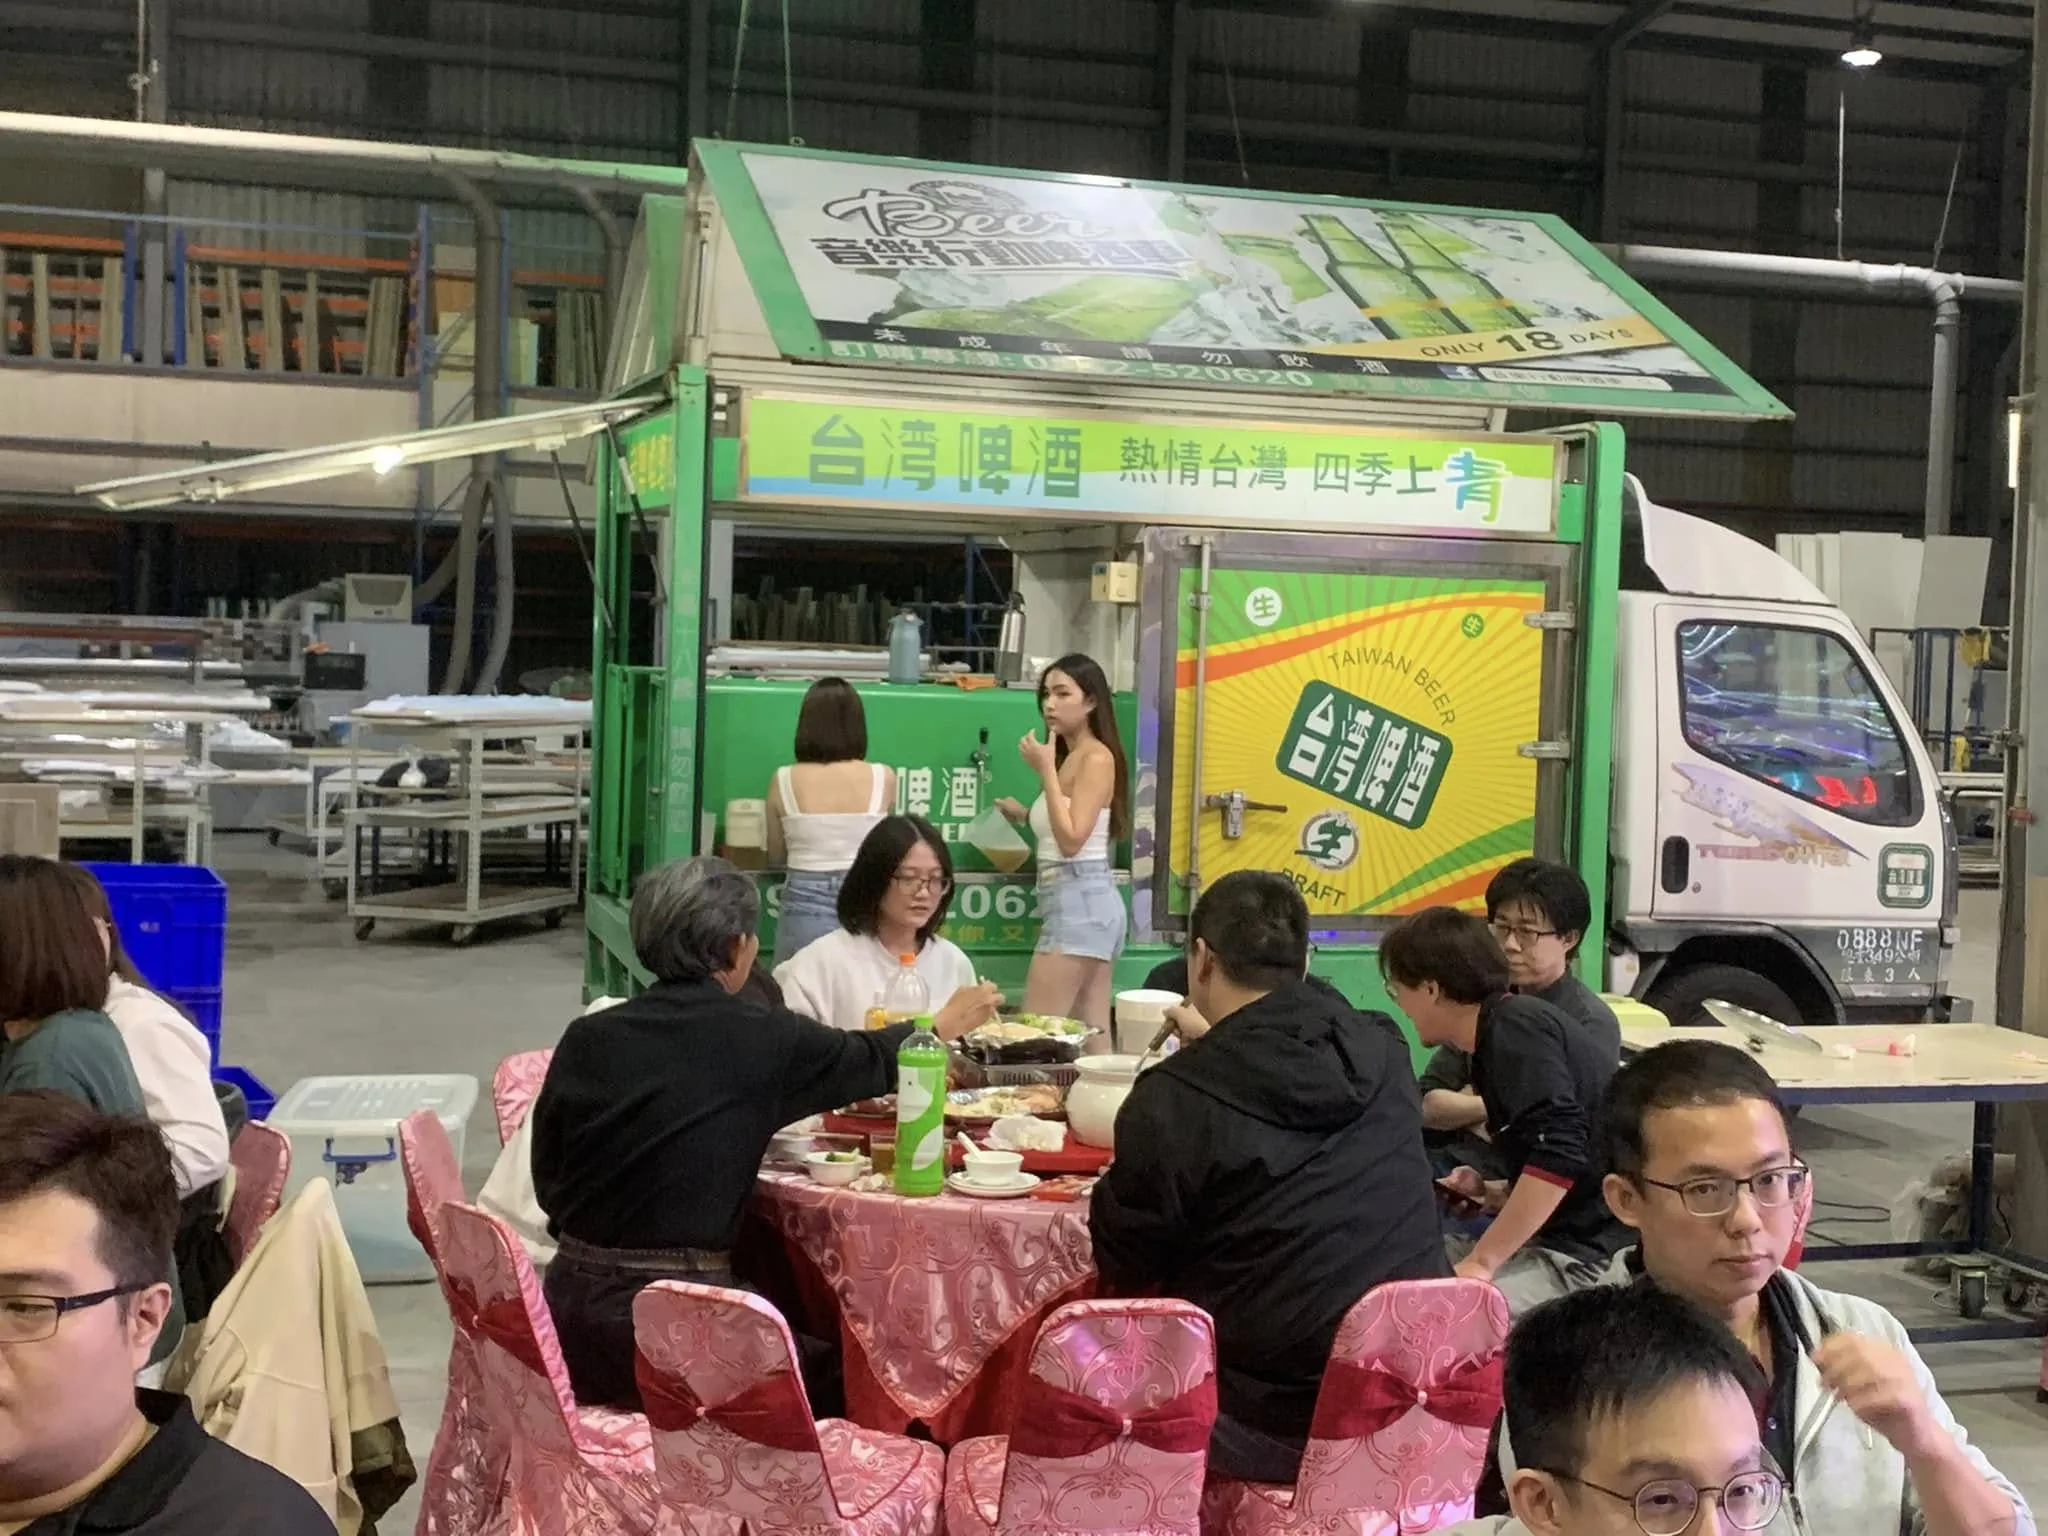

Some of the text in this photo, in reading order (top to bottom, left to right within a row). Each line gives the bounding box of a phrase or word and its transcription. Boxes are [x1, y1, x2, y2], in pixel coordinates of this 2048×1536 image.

[822, 188, 1108, 238] Beer
[1420, 328, 1634, 358] ONLY 18 DAYS
[1119, 436, 1288, 492] 熱情台灣
[1312, 447, 1512, 524] 四季上青
[1252, 593, 1277, 620] 生
[1328, 646, 1457, 727] TAIWAN BEER
[1282, 867, 1347, 907] DRAFT
